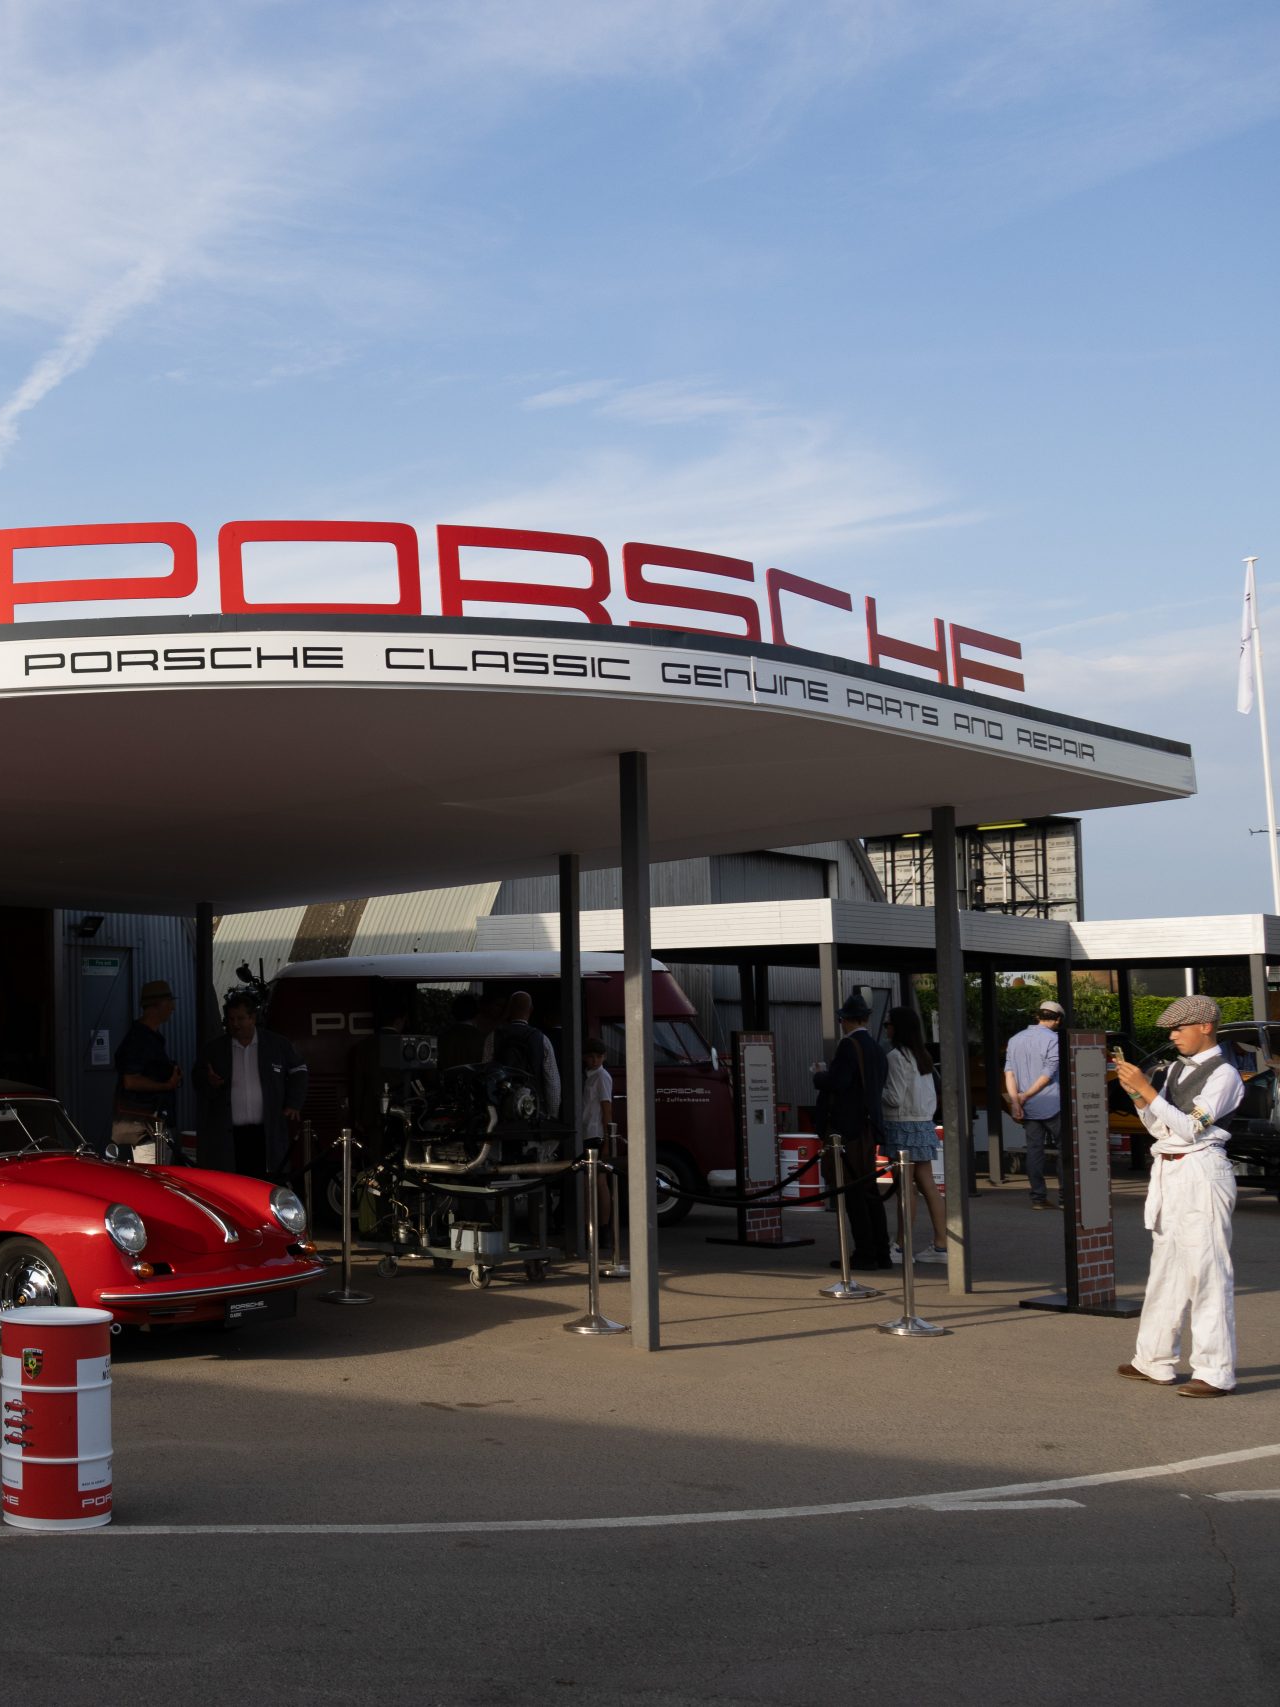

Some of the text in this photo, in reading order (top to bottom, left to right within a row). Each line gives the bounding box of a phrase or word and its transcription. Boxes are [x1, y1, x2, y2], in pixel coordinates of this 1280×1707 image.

[24, 646, 1096, 763] PORSCHE CLASSIC GENUINE PARTS AND REPAIR
[230, 1300, 265, 1310] PORSCHE
